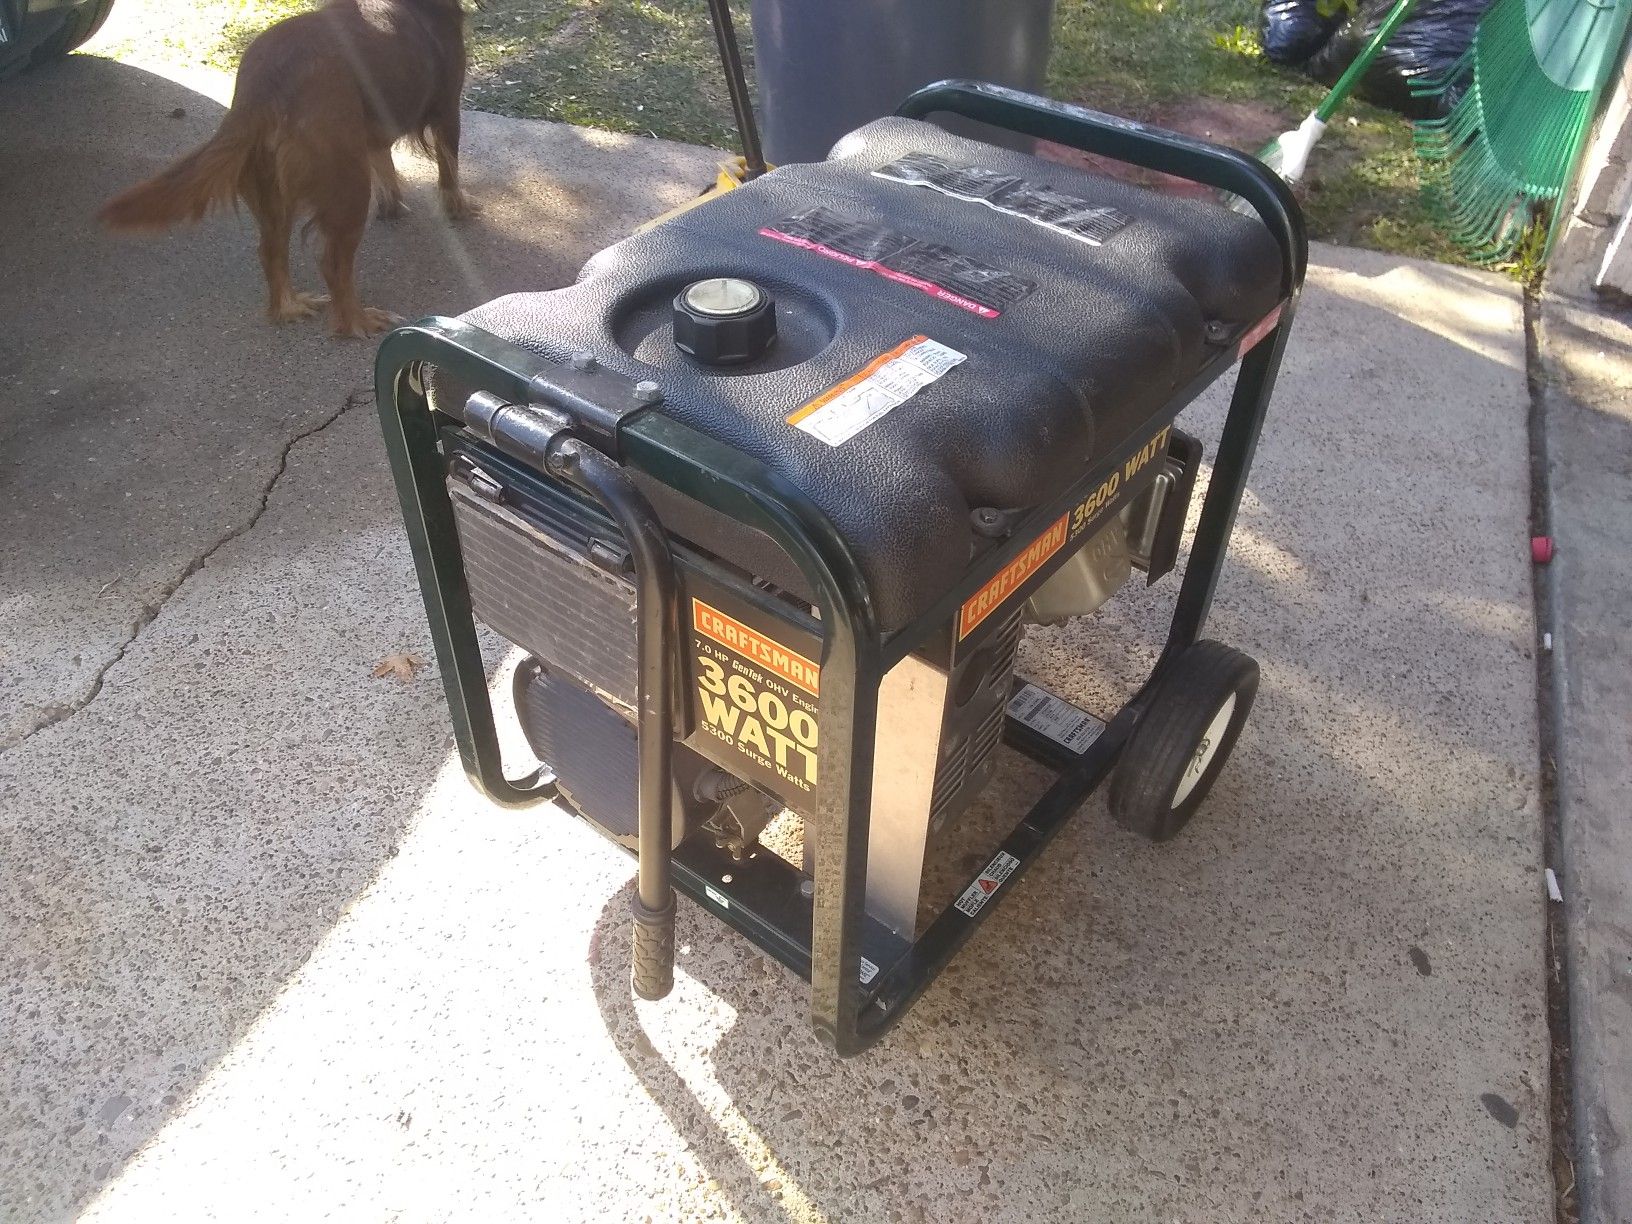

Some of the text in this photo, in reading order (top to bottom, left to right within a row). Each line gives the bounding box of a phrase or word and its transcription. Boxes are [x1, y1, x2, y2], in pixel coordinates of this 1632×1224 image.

[936, 290, 977, 310] DANGER
[1071, 424, 1172, 531] 3600 WATT
[967, 521, 1063, 624] CRAFTSMAN
[694, 639, 819, 714] 7.0 HP GenTek OHV Engin
[701, 611, 819, 689] CRAFTSMAN
[698, 656, 819, 748] 3600
[698, 687, 818, 785] WATT
[1063, 716, 1091, 744] CRAFTSMAN
[701, 720, 811, 792] 5300 Surge Watts
[956, 896, 966, 906] HOT
[960, 890, 979, 909] MUFFLER
